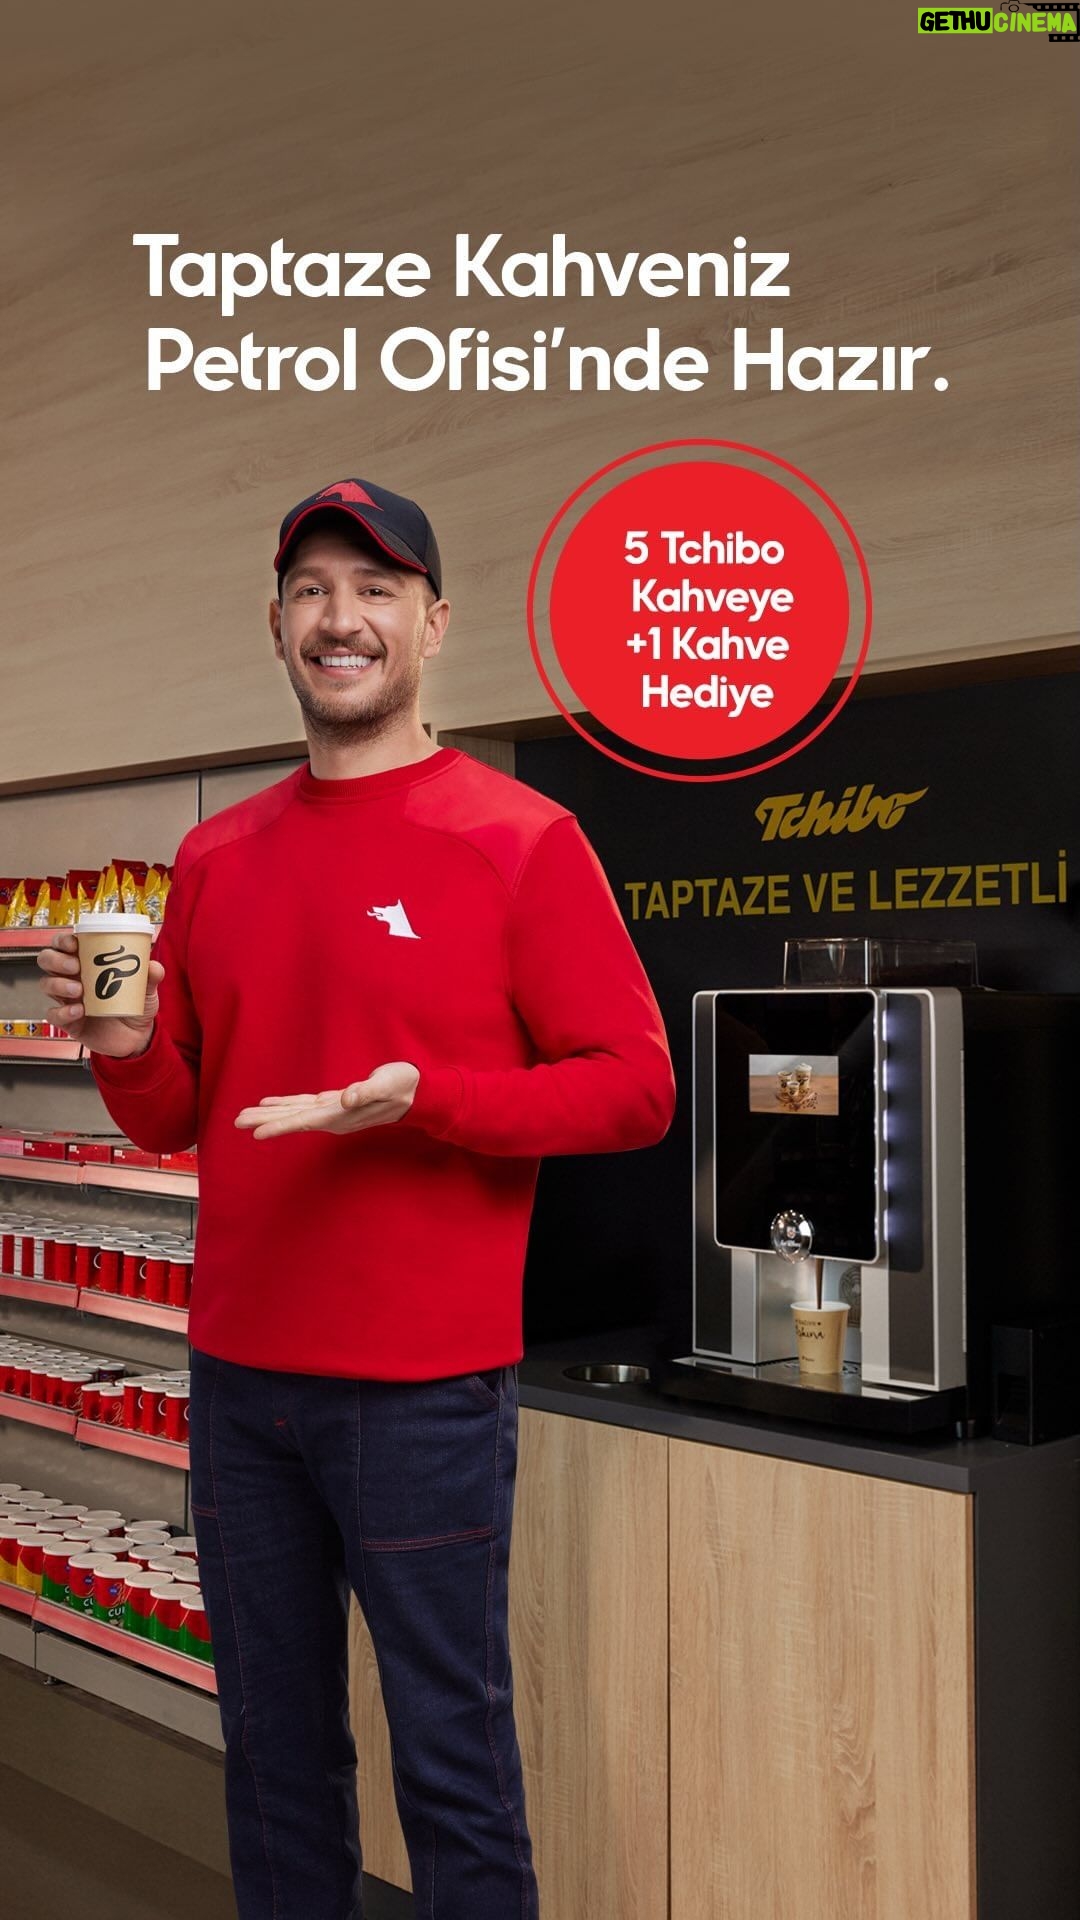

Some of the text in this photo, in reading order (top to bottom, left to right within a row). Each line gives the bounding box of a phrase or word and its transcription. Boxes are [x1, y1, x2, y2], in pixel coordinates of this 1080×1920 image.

[755, 784, 929, 841] Tchibo
[625, 850, 1067, 919] TAPTAZE VE LEZZETLİ
